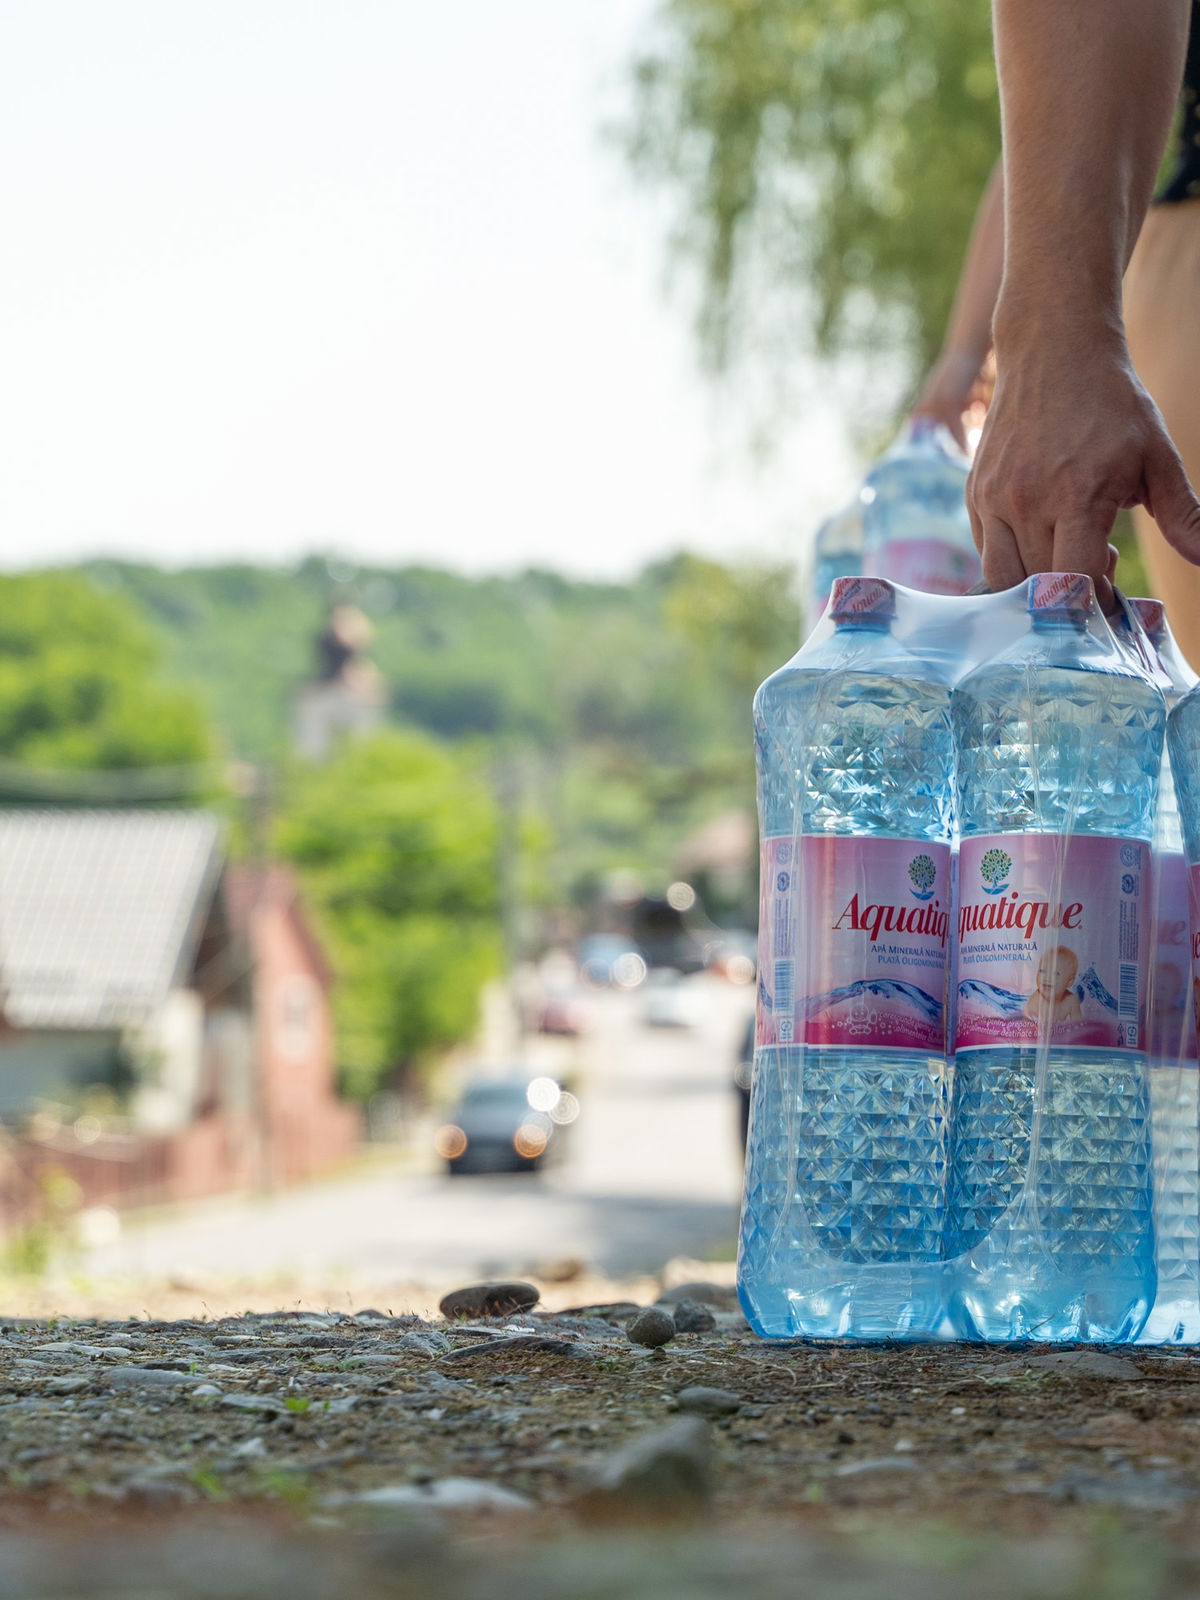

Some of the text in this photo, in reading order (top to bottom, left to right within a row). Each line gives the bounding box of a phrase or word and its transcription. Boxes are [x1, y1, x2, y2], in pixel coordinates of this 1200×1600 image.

[871, 944, 886, 953] APĂ
[889, 945, 924, 956] MINERALĂ
[997, 941, 1038, 951] NATURALĂ
[878, 955, 900, 965] PLATĂ
